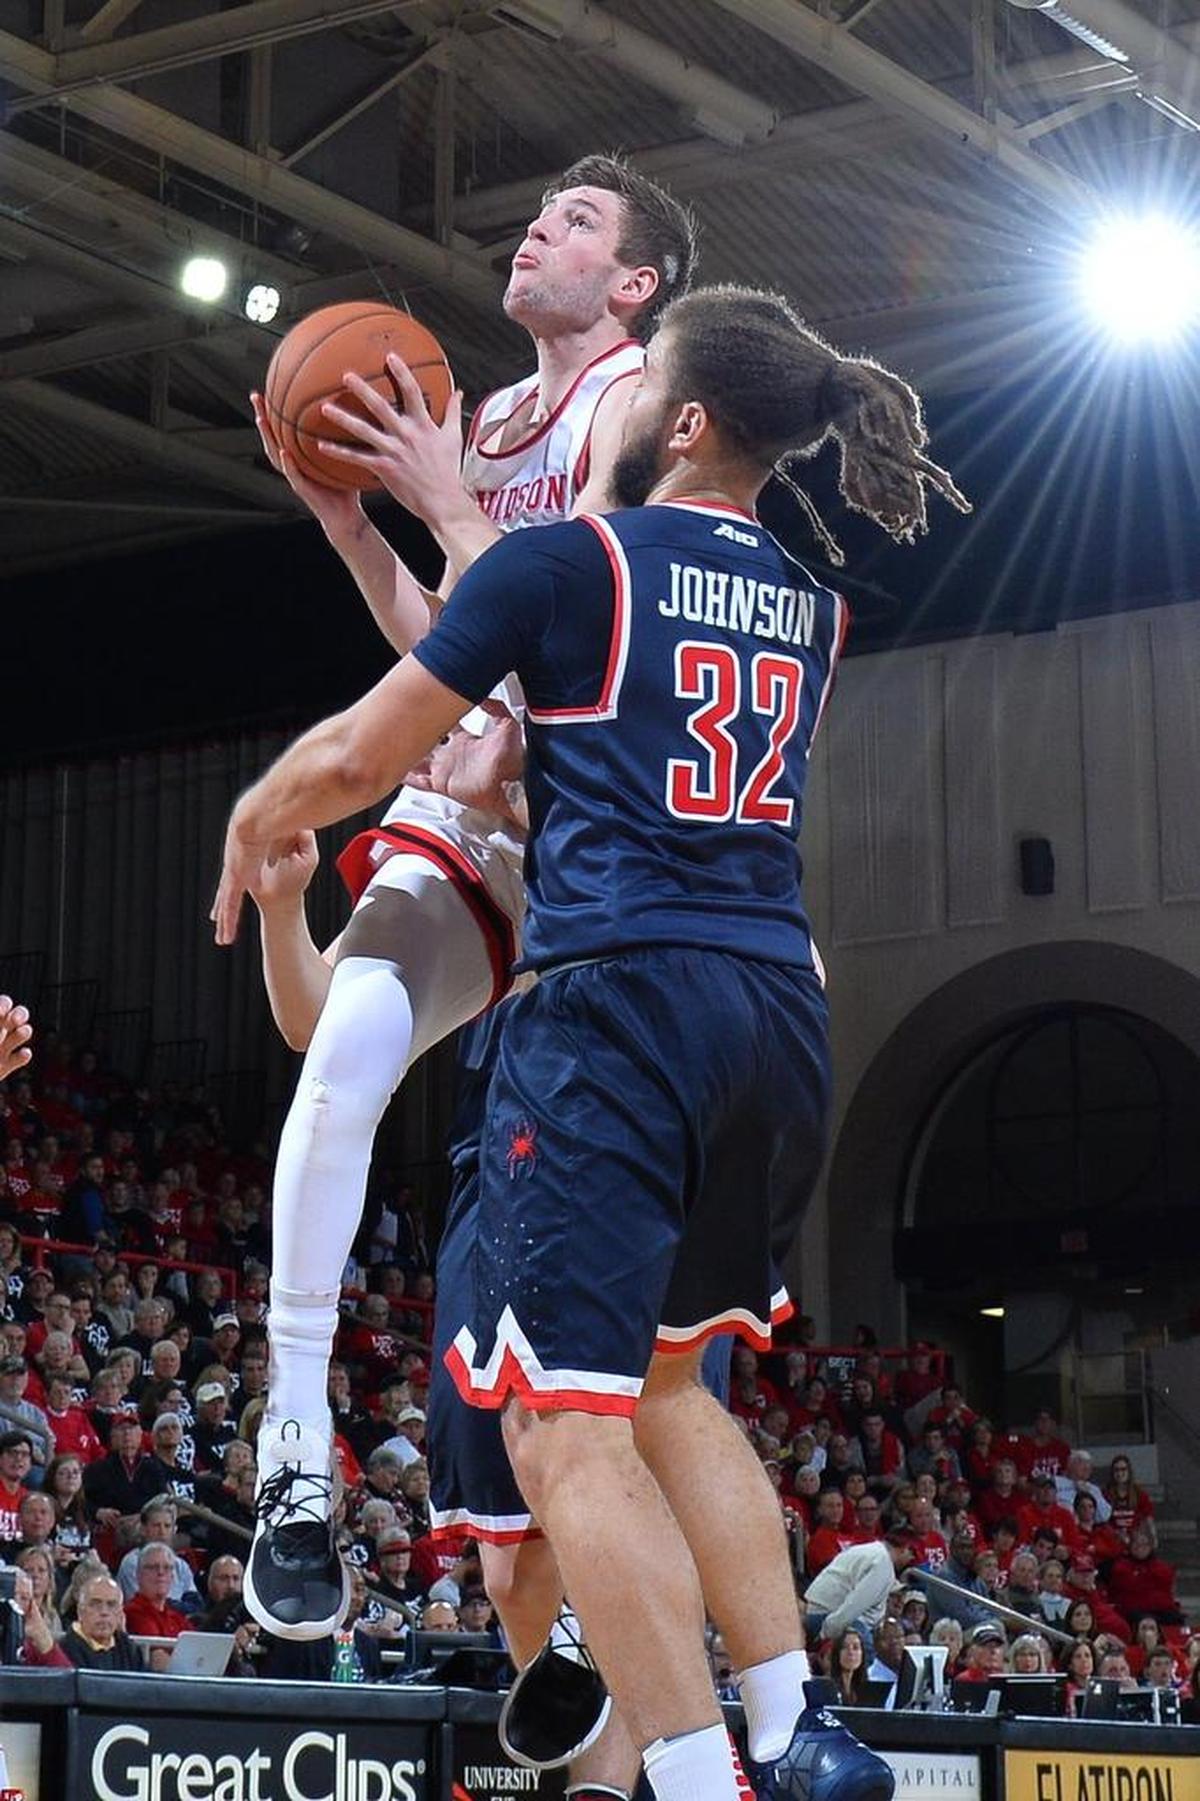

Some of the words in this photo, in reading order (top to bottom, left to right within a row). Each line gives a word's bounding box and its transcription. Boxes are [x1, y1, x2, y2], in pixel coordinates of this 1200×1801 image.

[658, 562, 816, 647] JOHNSON
[666, 639, 803, 827] 32
[91, 1724, 272, 1801] Great
[463, 1765, 542, 1791] UNIVERSITY
[900, 1768, 977, 1788] APITAL
